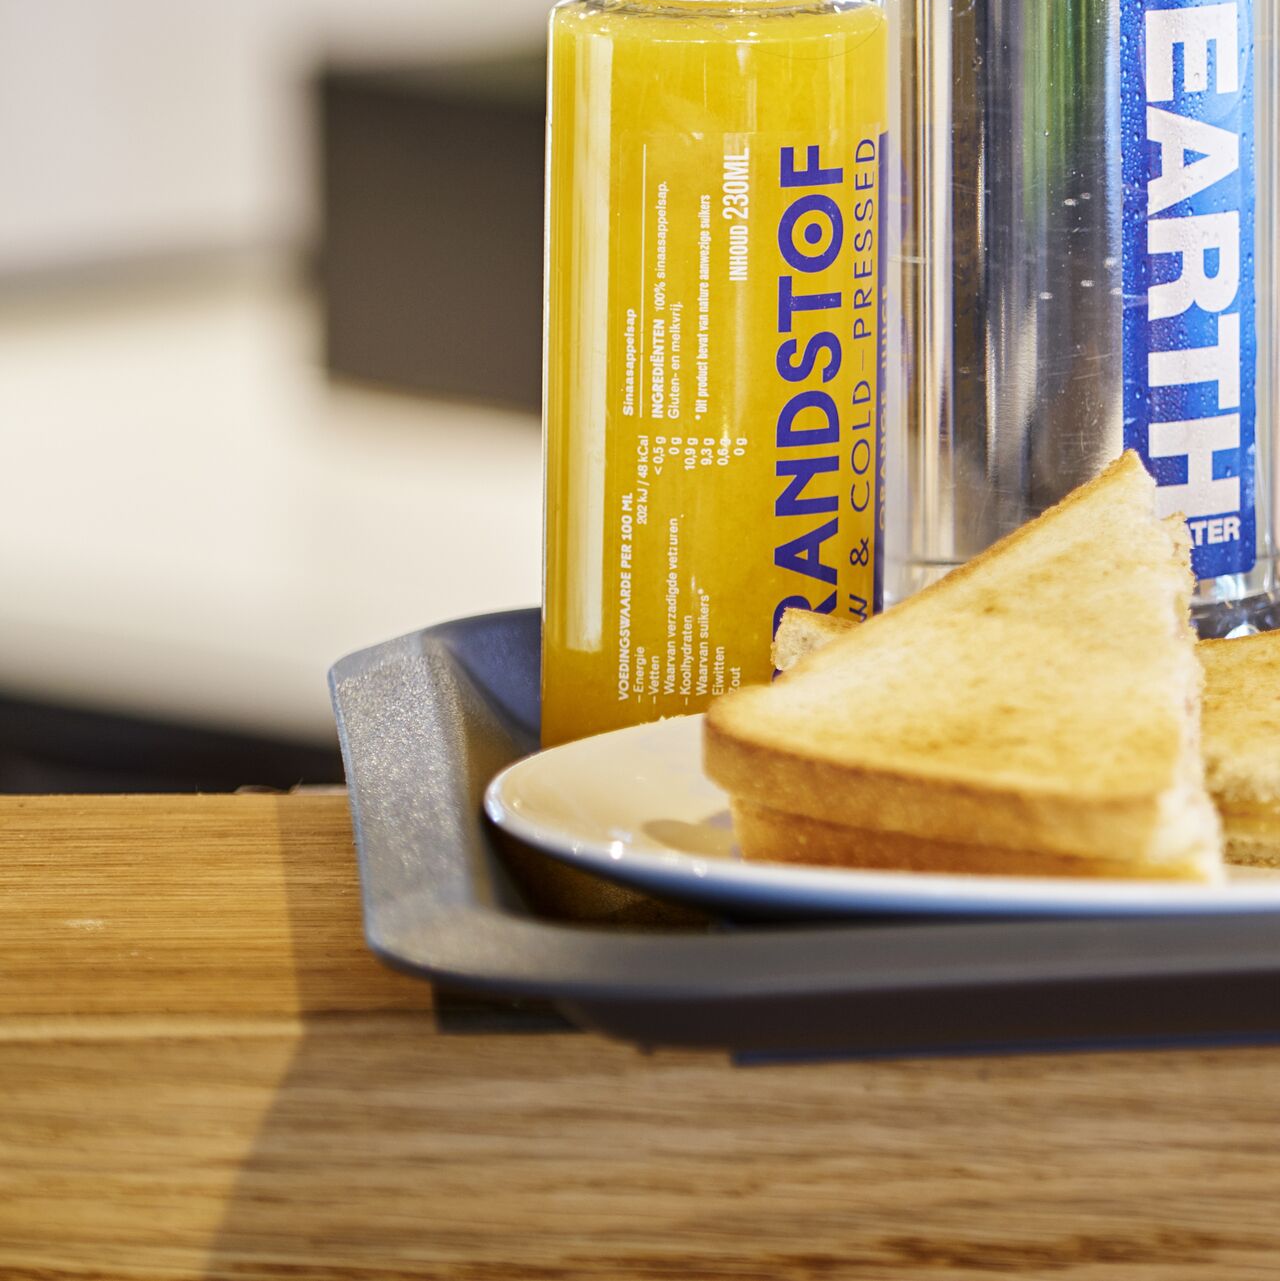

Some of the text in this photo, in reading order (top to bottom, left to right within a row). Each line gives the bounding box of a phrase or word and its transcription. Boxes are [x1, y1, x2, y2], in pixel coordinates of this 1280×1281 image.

[698, 195, 710, 228] suikers
[722, 147, 749, 281] INHOUD 230ML
[698, 231, 711, 280] aanwezige
[1144, 2, 1240, 519] EARTH
[650, 181, 669, 418] INGREDIËNTEN 100% sinaasappelsap.
[698, 282, 709, 312] nature
[699, 315, 709, 331] van
[623, 309, 637, 416] Sinaasappelsap
[668, 301, 683, 419] Gluten- en melkvrij.
[696, 334, 709, 359] bevat
[696, 362, 709, 397] product
[772, 145, 843, 683] RANDSTOF
[637, 435, 648, 462] kCal
[653, 447, 665, 464] 0,5
[655, 436, 666, 444] g
[671, 437, 682, 445] g
[701, 448, 713, 465] 9,3
[703, 438, 715, 446] g
[736, 438, 747, 446] g
[638, 465, 648, 478] 48
[684, 448, 697, 470] 10,9
[637, 489, 648, 502] kJ
[637, 505, 647, 525] 202
[1187, 516, 1241, 547] TER
[849, 537, 868, 566] &
[618, 493, 632, 700] VOEDINGSWAARDE PER 100 ML
[666, 572, 679, 637] verzadigde
[633, 646, 646, 693] Energie
[664, 641, 676, 695] Waarvan
[680, 615, 694, 695] Koolhydraten
[696, 642, 708, 695] Waarvan
[712, 646, 725, 695] Eiwitten
[648, 656, 659, 695] Vetten
